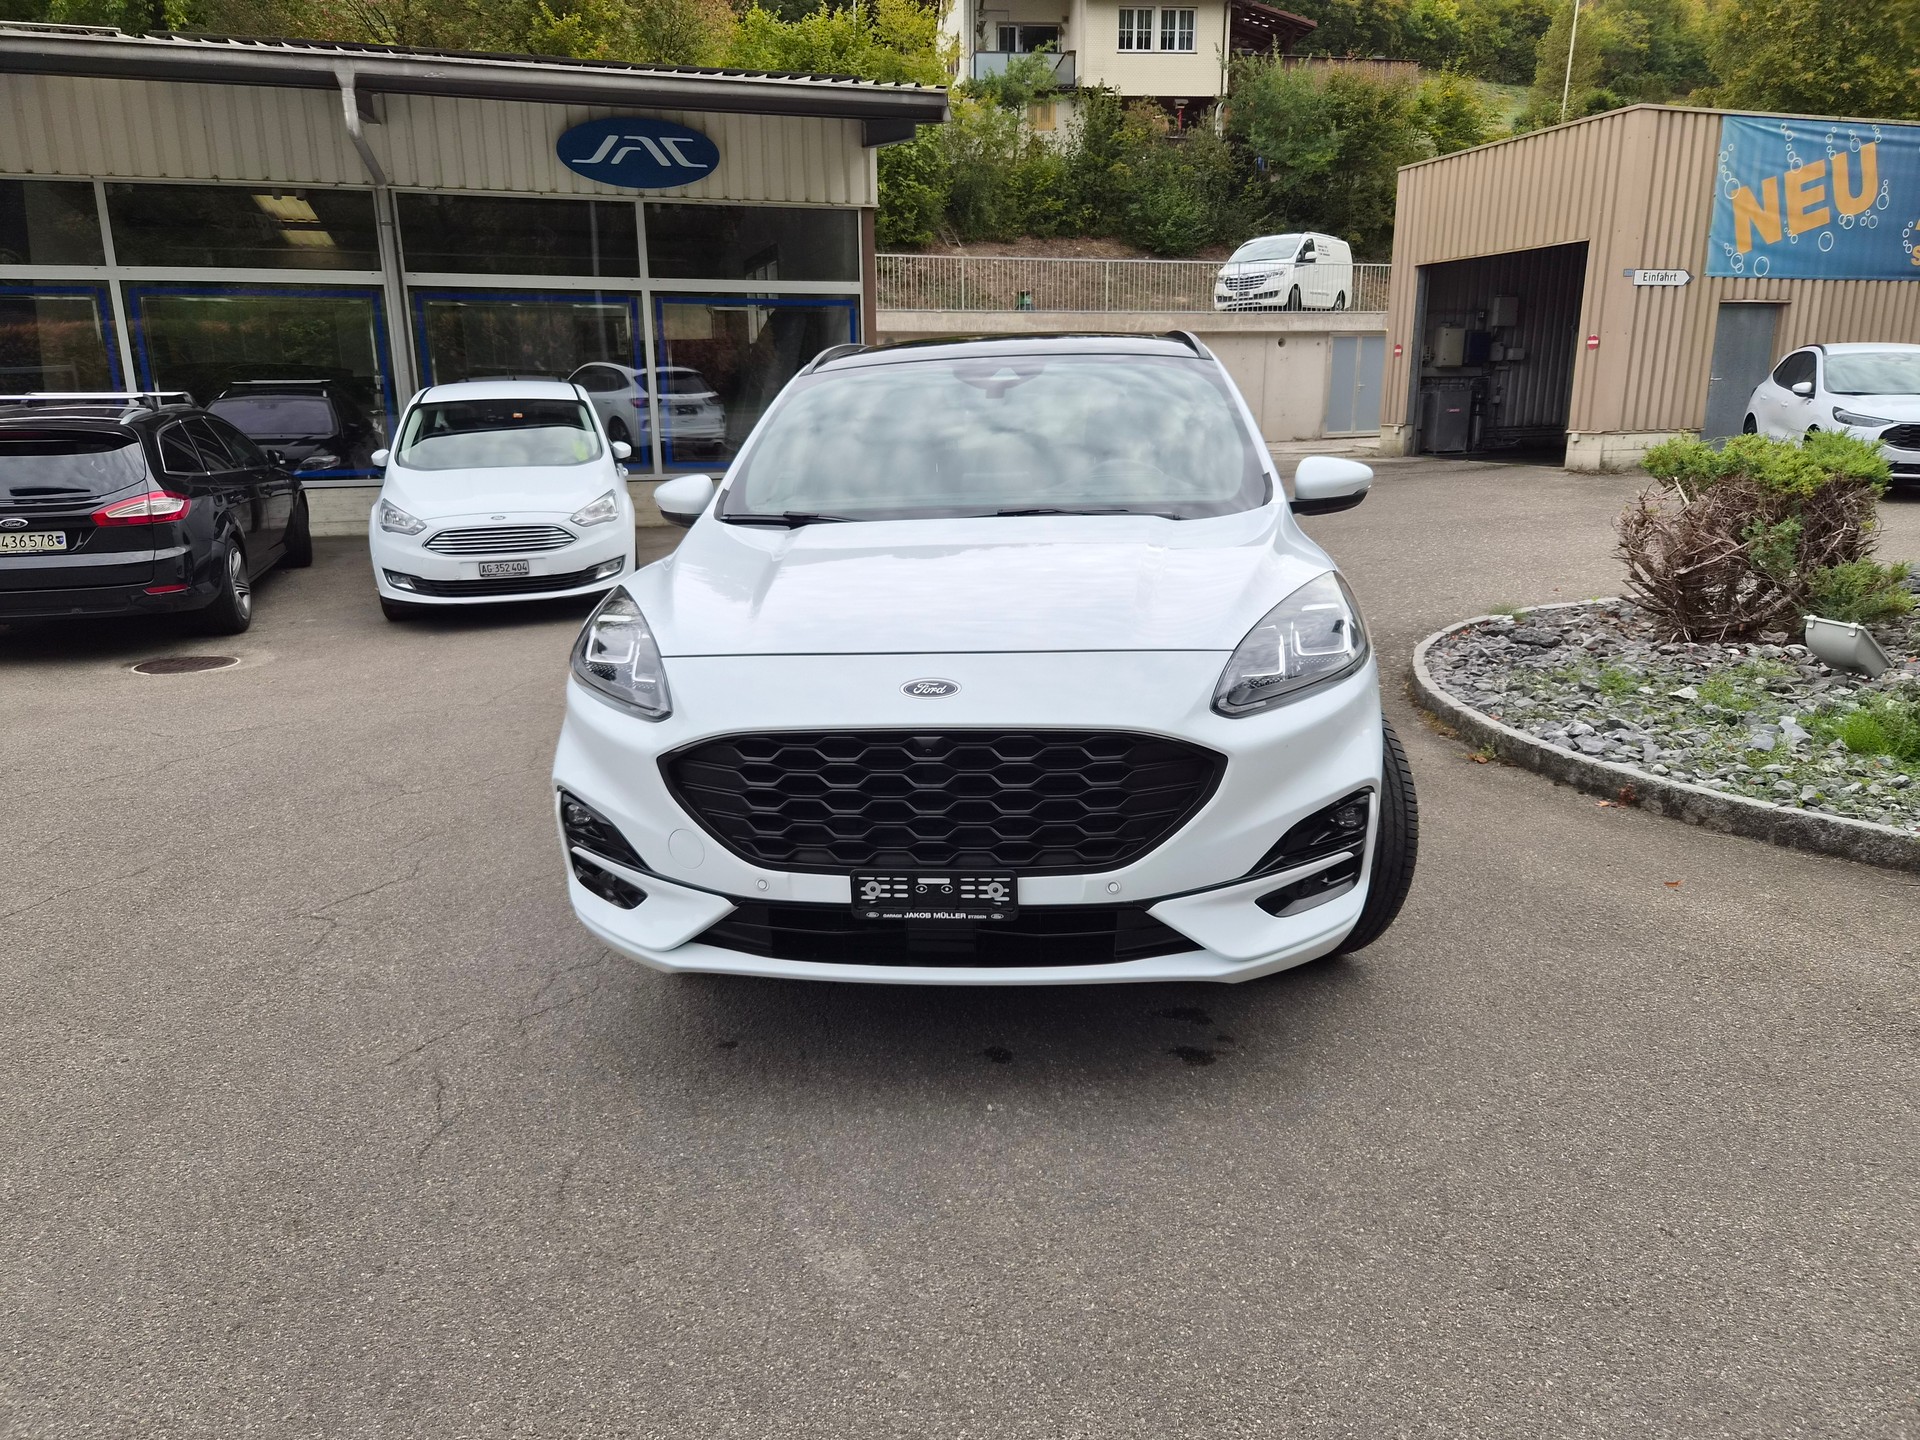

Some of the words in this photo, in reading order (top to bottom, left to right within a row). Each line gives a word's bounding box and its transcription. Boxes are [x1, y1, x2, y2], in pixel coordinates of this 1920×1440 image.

[571, 134, 709, 168] JAC
[1731, 141, 1879, 255] NEU
[1642, 271, 1678, 282] Einfahrt
[481, 564, 493, 573] AG
[913, 682, 947, 694] Ford
[933, 911, 967, 919] MÜLLER
